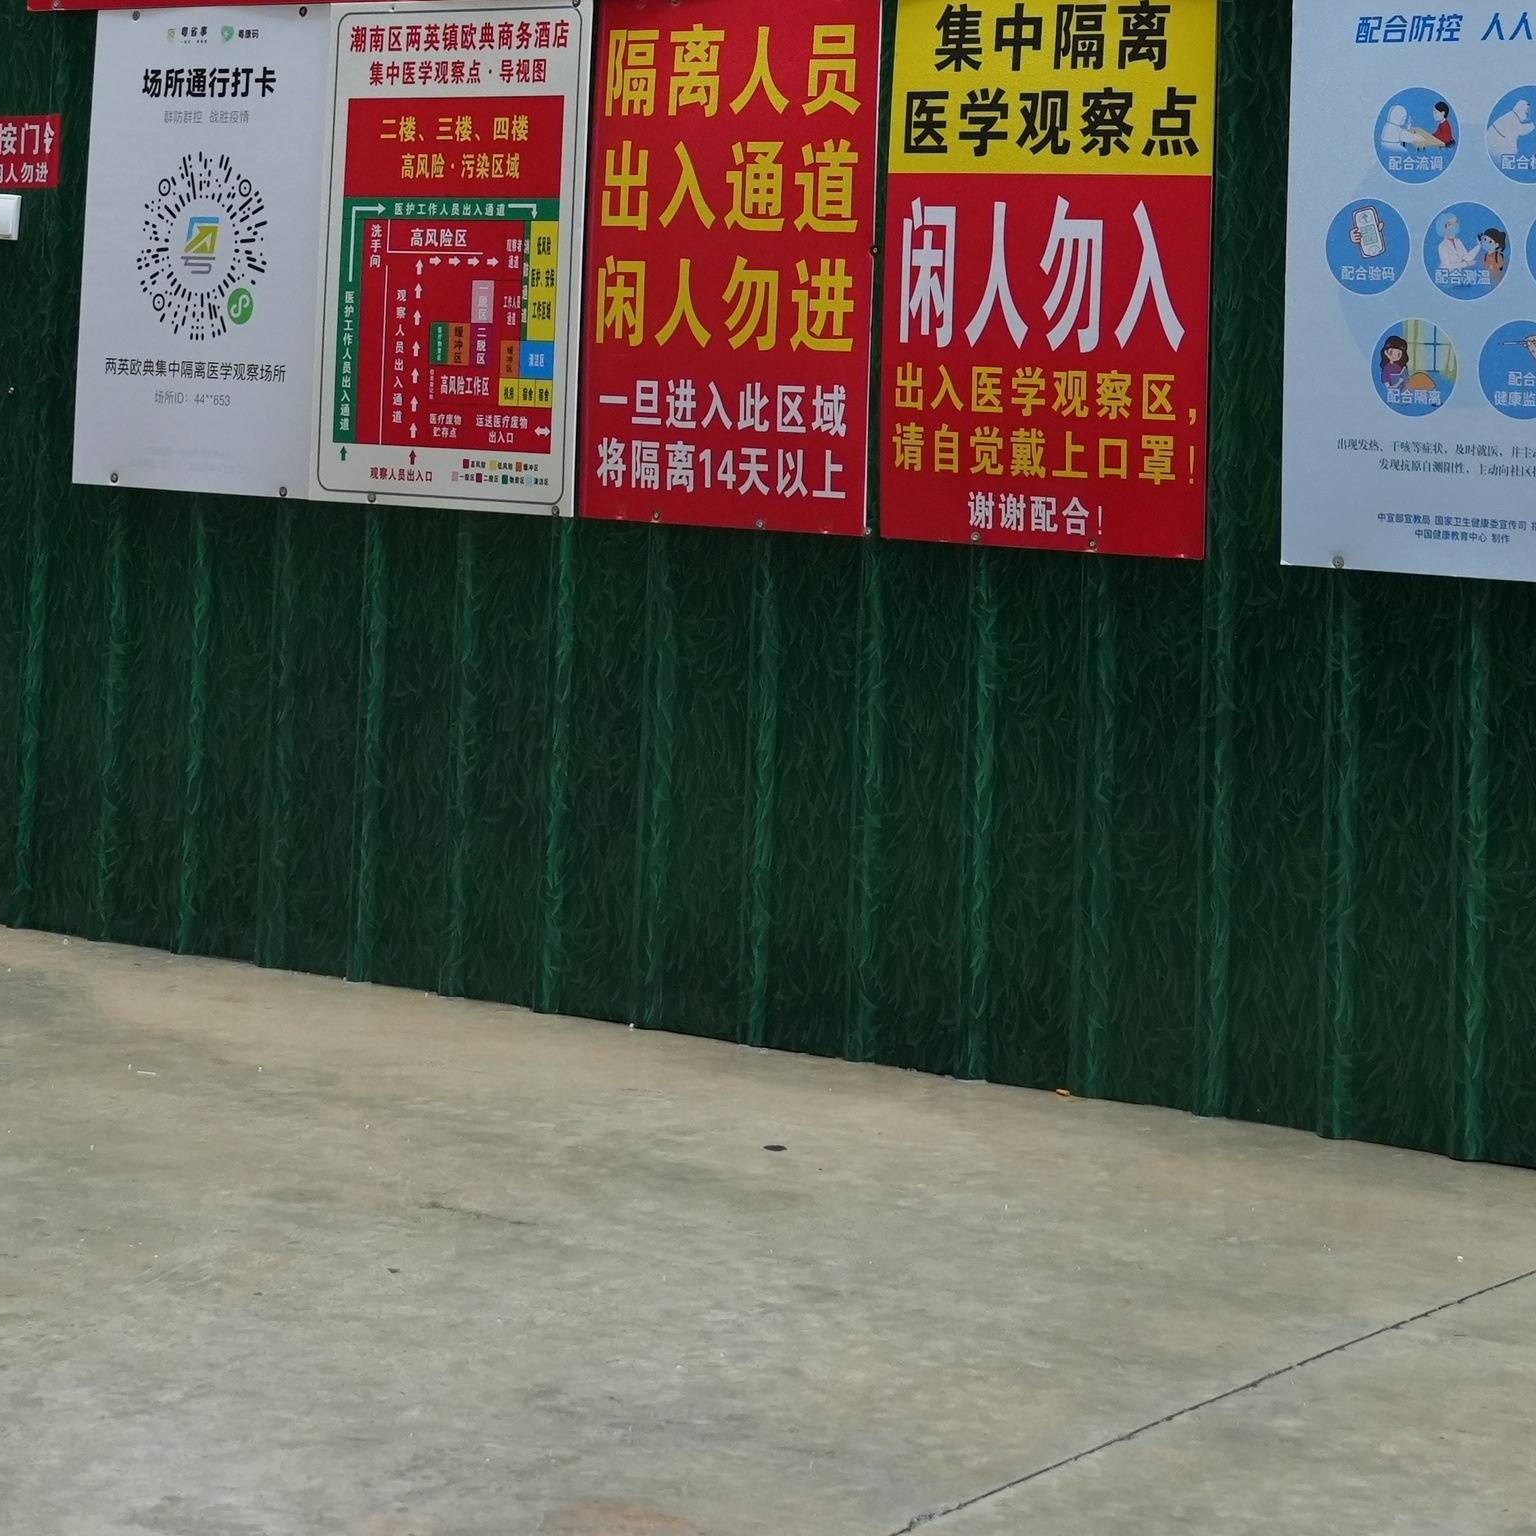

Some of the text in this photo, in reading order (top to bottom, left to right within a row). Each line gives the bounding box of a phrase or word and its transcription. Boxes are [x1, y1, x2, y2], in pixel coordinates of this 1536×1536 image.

[350, 19, 570, 53] 潮南区两英镇欧典商务酒店
[934, 0, 1173, 73] 集中隔离
[1355, 12, 1465, 44] 配合防控
[141, 66, 277, 98] 场所通行打卡
[603, 22, 863, 118] 隔离人员
[163, 110, 250, 125] 群防群控 战胜疫情
[380, 114, 530, 142] 二楼、三楼、四楼
[902, 86, 1200, 158] 医学观察点
[1387, 155, 1444, 171] 配合流调
[599, 138, 860, 234] 出入通道
[393, 202, 506, 217] 医护工作人员出入通道
[369, 223, 383, 268] 洗手间
[410, 228, 467, 247] 高风险区
[898, 194, 1187, 354] 闲人勿入
[1340, 265, 1396, 282] 配合验码
[1434, 269, 1492, 286] 配合测温
[594, 255, 856, 354] 闲人勿进
[339, 291, 355, 431] 医护工作人员出入通道
[392, 289, 407, 424] 观察人员出入通道
[476, 327, 487, 365] 二脱区
[104, 357, 287, 383] 两英欧典集中隔离医学观察场所
[1507, 370, 1536, 388] 配合
[440, 375, 490, 397] 高风险工作区
[894, 361, 1199, 426] 出入医学观察区，
[1386, 388, 1442, 406] 配合隔离
[429, 413, 462, 425] 医疗废物
[475, 413, 529, 429] 运送医疗废物
[598, 378, 848, 438] 一旦进入此区域
[432, 426, 457, 439] 贮存点
[488, 430, 514, 444] 出入口
[892, 421, 1197, 486] 请自觉戴上口罩！
[369, 467, 433, 483] 观察人员出入口
[596, 437, 847, 501] 将隔离14天以上
[967, 491, 1105, 537] 谢谢配合！
[1377, 512, 1431, 526] 中宣部宣教局
[1414, 528, 1511, 544] 中国健康教育中心 制作
